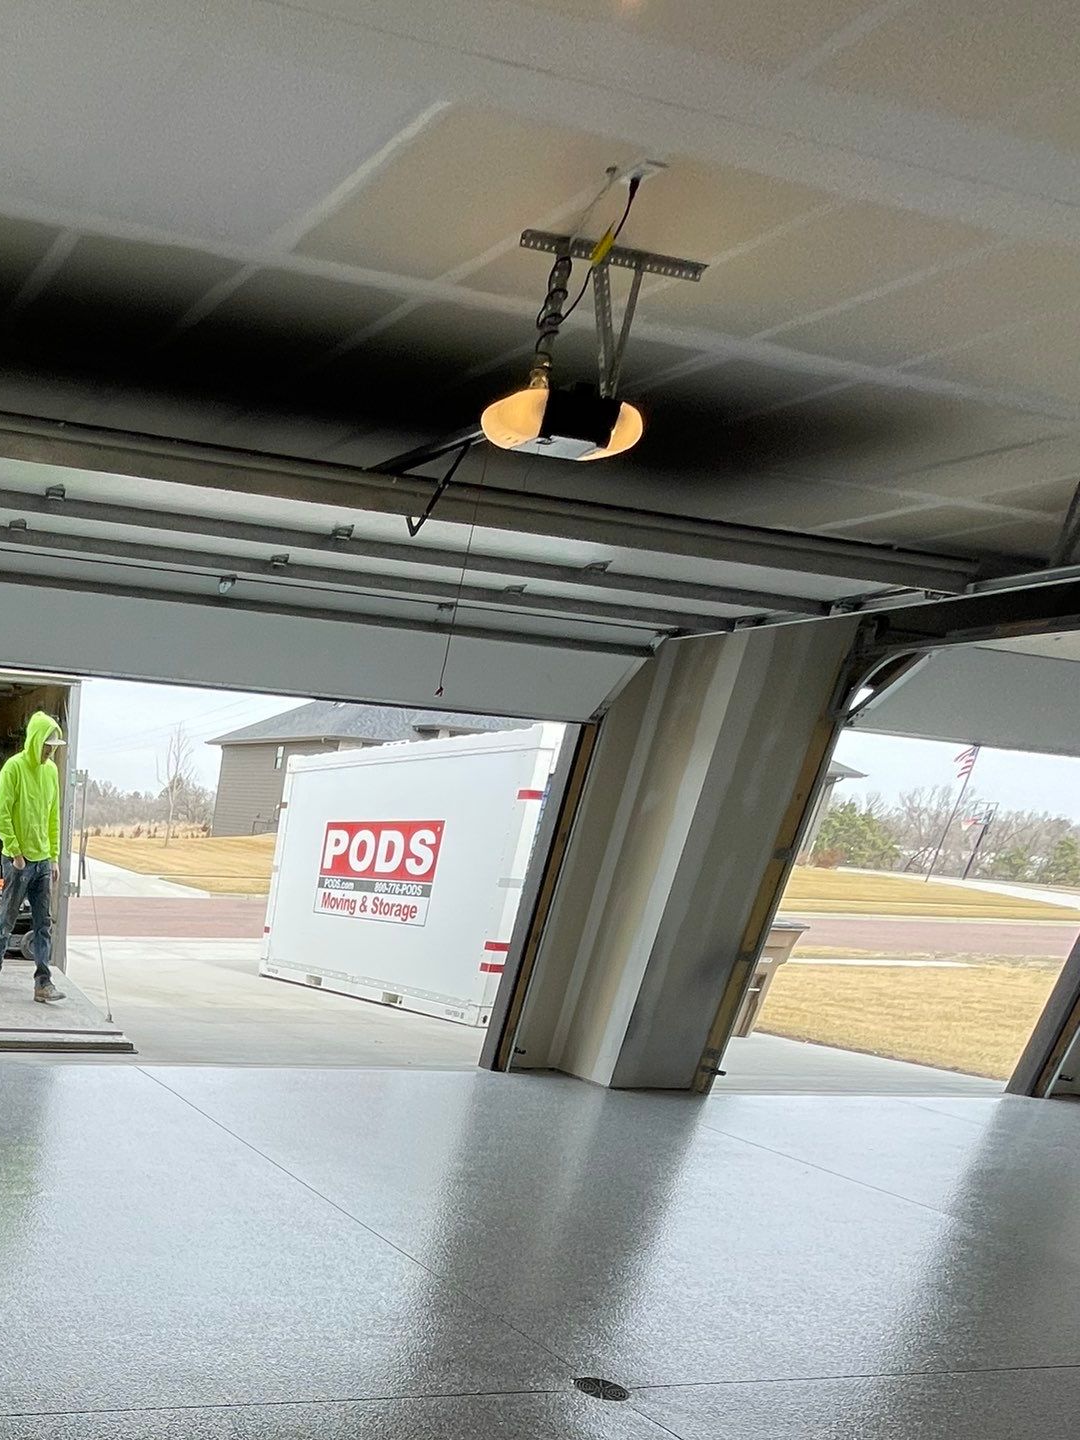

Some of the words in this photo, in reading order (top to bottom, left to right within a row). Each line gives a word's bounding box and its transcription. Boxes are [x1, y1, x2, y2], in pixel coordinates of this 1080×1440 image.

[323, 829, 436, 875] PODS
[324, 879, 354, 890] PODS.com
[322, 892, 357, 915] Moving
[360, 895, 367, 913] &
[371, 896, 418, 921] Storage
